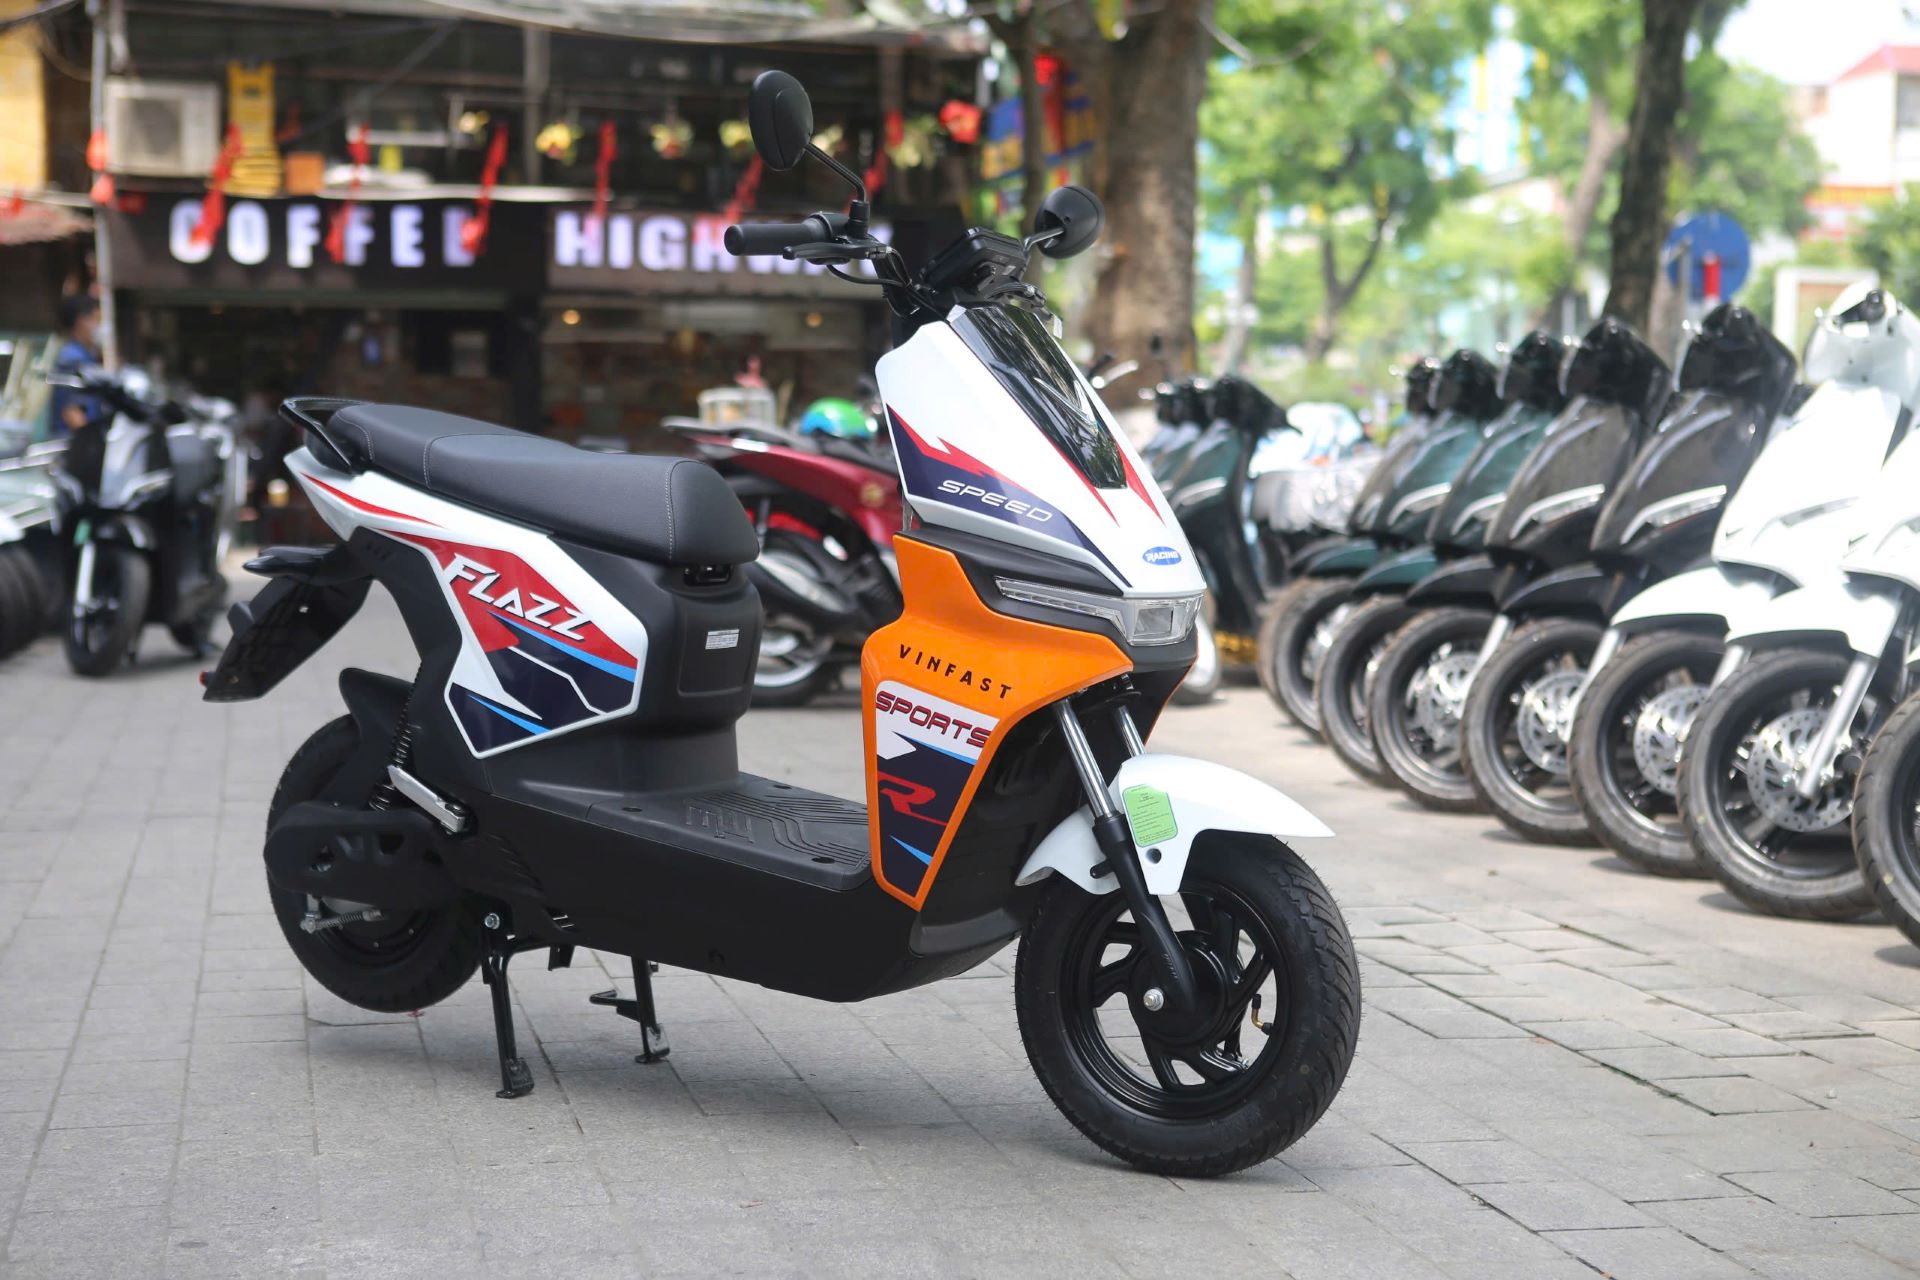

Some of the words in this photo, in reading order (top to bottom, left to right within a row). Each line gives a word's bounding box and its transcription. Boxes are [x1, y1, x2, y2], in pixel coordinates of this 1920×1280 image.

[937, 480, 1052, 522] SPEED
[1144, 551, 1180, 562] RACING
[444, 552, 592, 641] FLAZZ
[900, 644, 1012, 699] VINFAST
[875, 690, 993, 748] SPORTS
